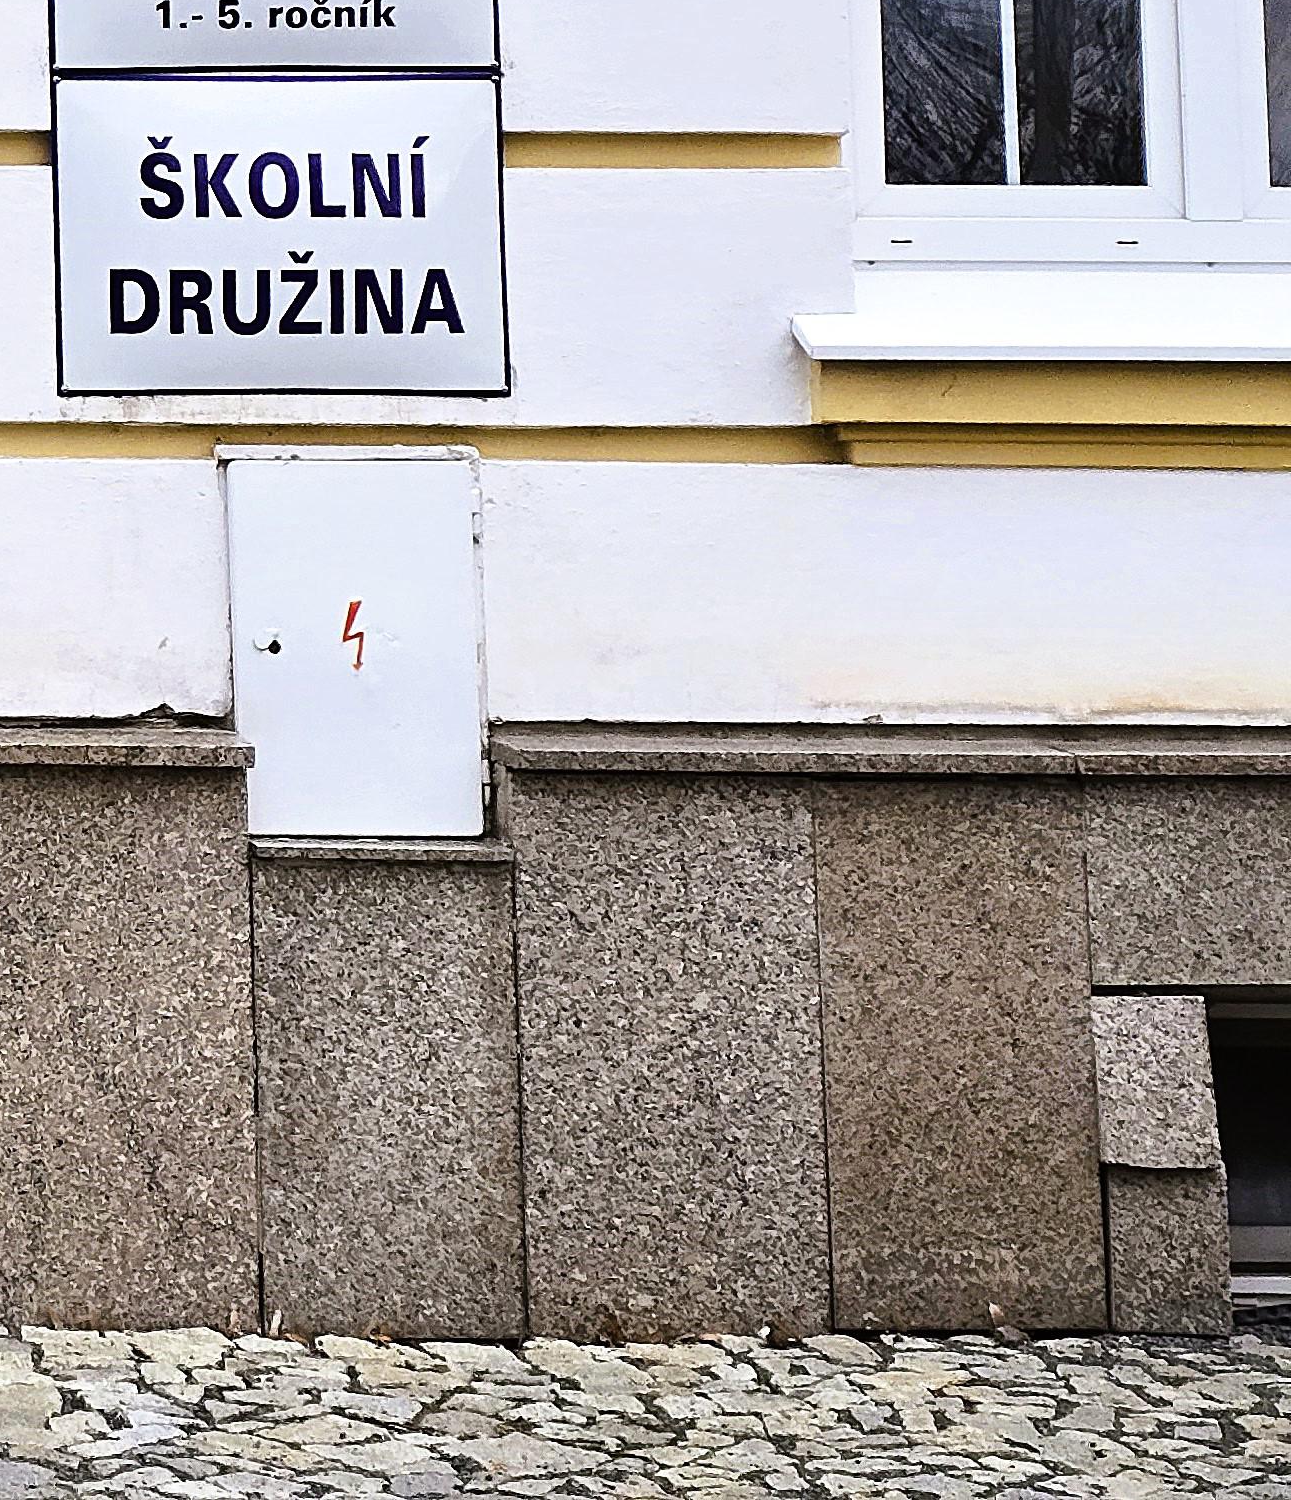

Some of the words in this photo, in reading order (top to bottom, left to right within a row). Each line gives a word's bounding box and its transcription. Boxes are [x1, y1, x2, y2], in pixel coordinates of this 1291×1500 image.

[217, 0, 253, 30] 5.
[268, 0, 397, 29] ročník
[139, 135, 430, 220] ŠKOLNÍ
[109, 250, 466, 335] DRUŽINA
